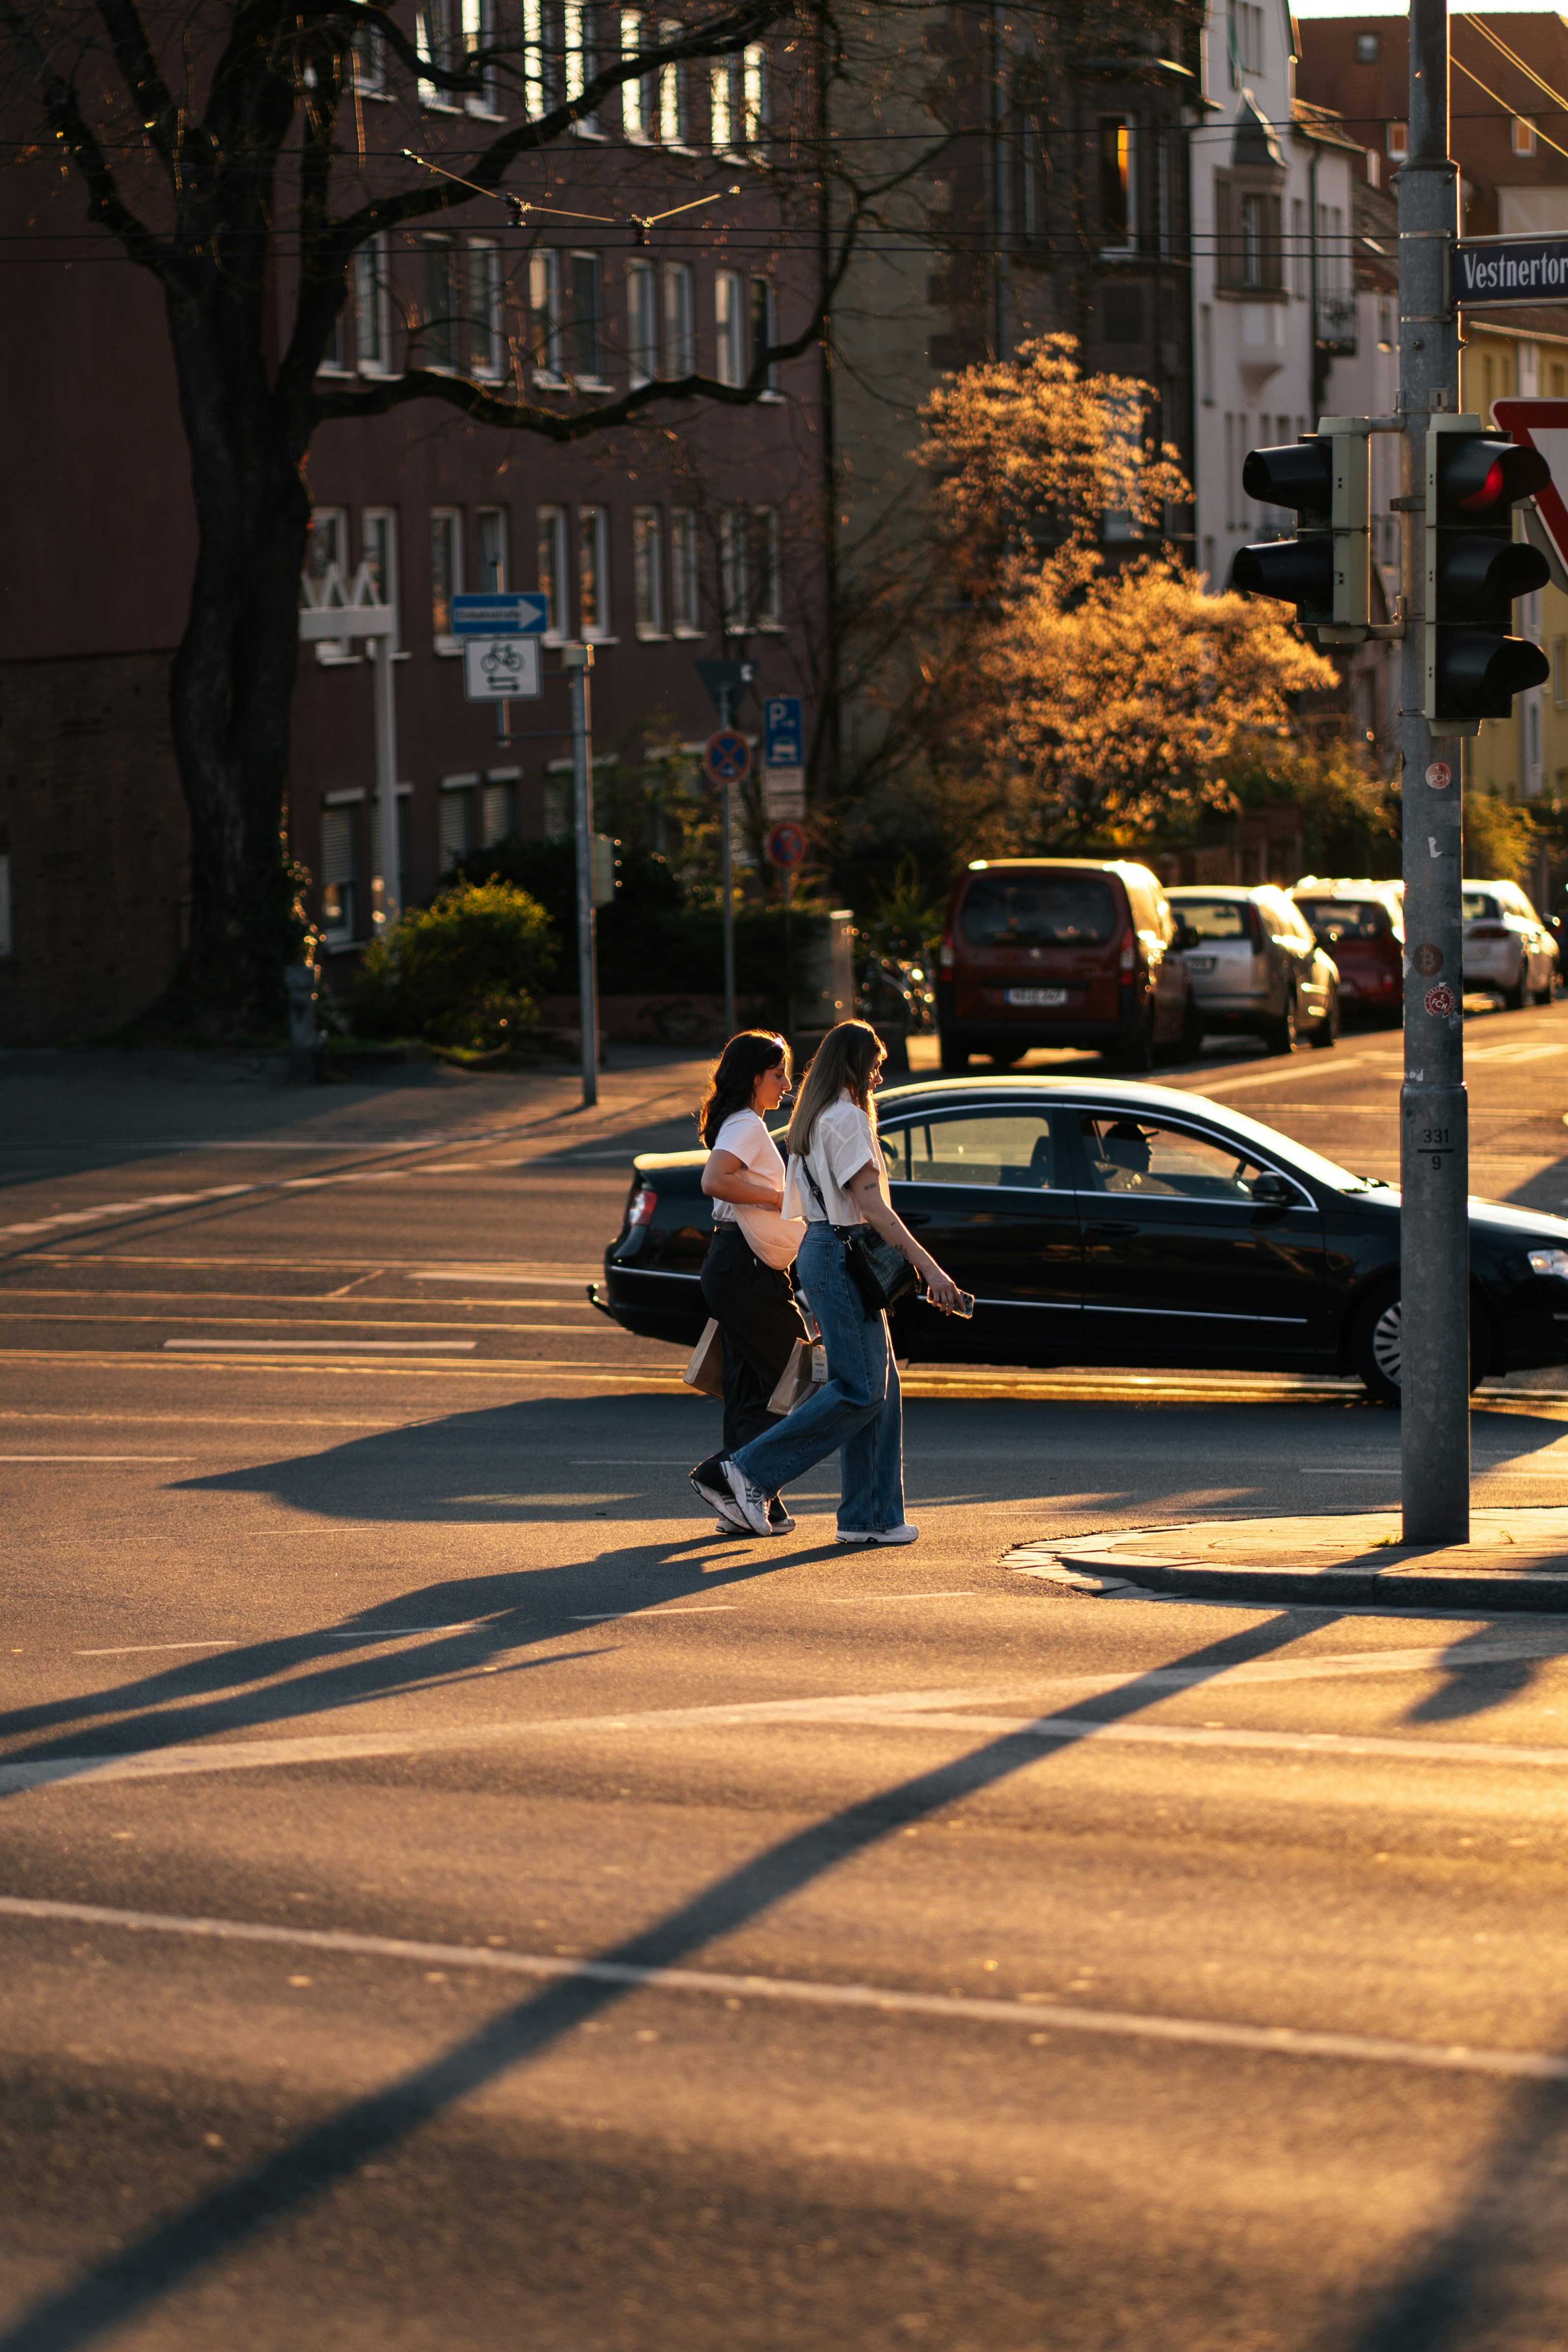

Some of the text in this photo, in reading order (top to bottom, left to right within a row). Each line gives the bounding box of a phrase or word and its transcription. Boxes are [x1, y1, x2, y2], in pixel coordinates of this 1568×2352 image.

[1463, 251, 1568, 289] Vestnertor
[769, 702, 788, 731] P
[1429, 772, 1449, 783] FCN
[1431, 998, 1448, 1010] FCN
[1424, 1128, 1449, 1143] 331
[1432, 1155, 1441, 1170] 9
